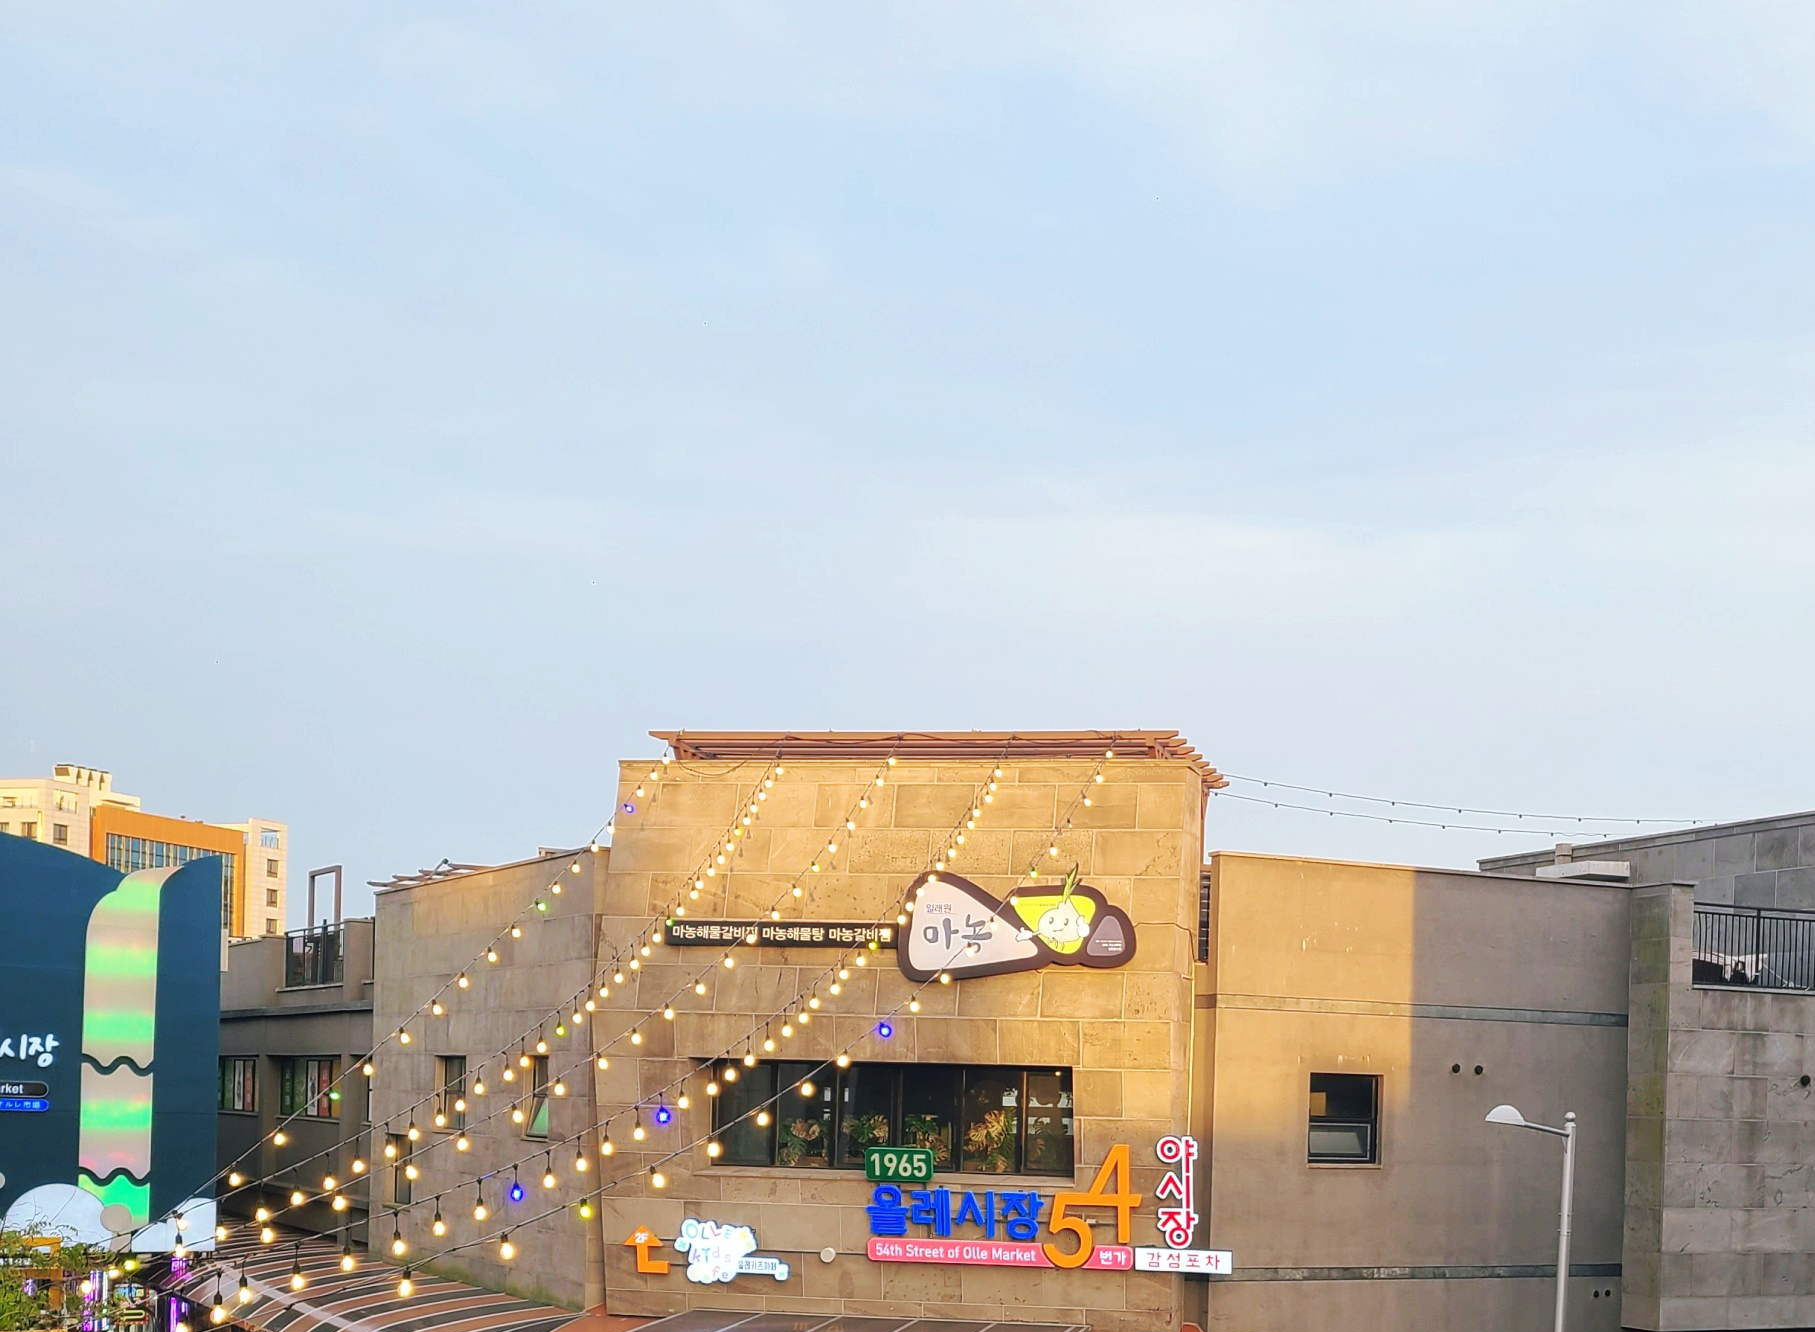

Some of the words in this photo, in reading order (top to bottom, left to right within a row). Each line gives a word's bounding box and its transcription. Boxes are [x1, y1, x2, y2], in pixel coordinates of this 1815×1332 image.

[762, 927, 824, 942] 마농해물탕
[923, 914, 993, 954] 마농
[870, 1153, 927, 1177] 1965
[1159, 1138, 1197, 1247] 야시장
[865, 1184, 1045, 1240] 올레시장
[1043, 1143, 1142, 1268] 54
[1099, 1250, 1126, 1265] 번가
[635, 1232, 649, 1243] 2F
[685, 1223, 733, 1240] OLLE
[876, 1243, 902, 1257] 54th
[906, 1244, 944, 1258] Street
[948, 1245, 960, 1259] of
[963, 1246, 987, 1260] Olle
[992, 1247, 1036, 1262] Market
